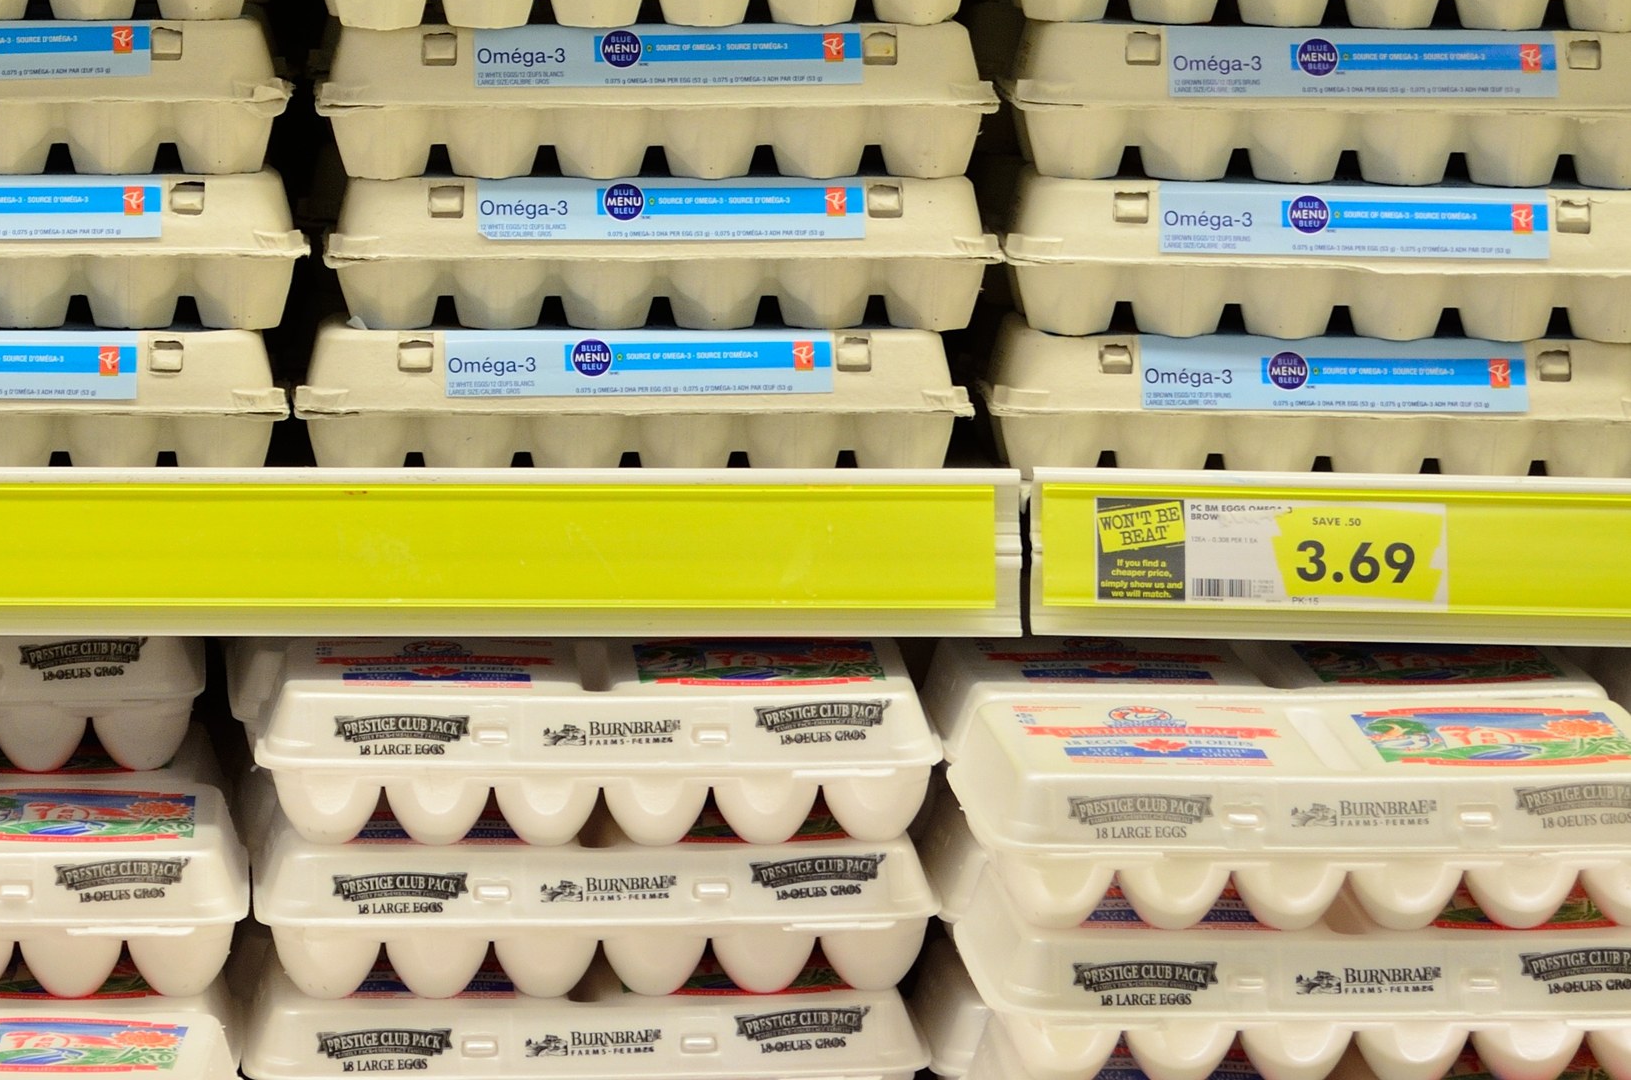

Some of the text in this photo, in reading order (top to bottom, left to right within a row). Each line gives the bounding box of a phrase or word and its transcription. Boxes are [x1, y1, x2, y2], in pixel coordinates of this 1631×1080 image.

[477, 47, 566, 65] Oméga-3
[1173, 55, 1262, 73] Oméga-3
[613, 188, 634, 196] BLUE
[658, 197, 682, 205] SOURCE
[684, 197, 692, 205] OF
[728, 197, 753, 205] SOURCE
[480, 199, 568, 218] Oméga-3
[606, 196, 642, 207] MENU
[613, 207, 635, 215] BLEU
[1164, 210, 1252, 228] Oméga-3
[448, 356, 536, 375] Oméga-3
[1144, 368, 1232, 386] Oméga-3
[1099, 507, 1180, 531] WON'T BE
[1312, 517, 1361, 526] SAVE .50
[1120, 526, 1167, 546] BEAT
[1297, 540, 1415, 583] 3.69
[1292, 597, 1318, 605] PK:15
[765, 704, 817, 727] PRESTIGE
[819, 702, 849, 718] CLUB
[851, 702, 881, 719] PACK
[589, 720, 672, 736] BURNBRAE
[1078, 796, 1201, 817] PRESTIGE CLUB PACK
[1340, 800, 1429, 817] BURNBRAE
[1096, 826, 1187, 839] 18 LARGE EGGS
